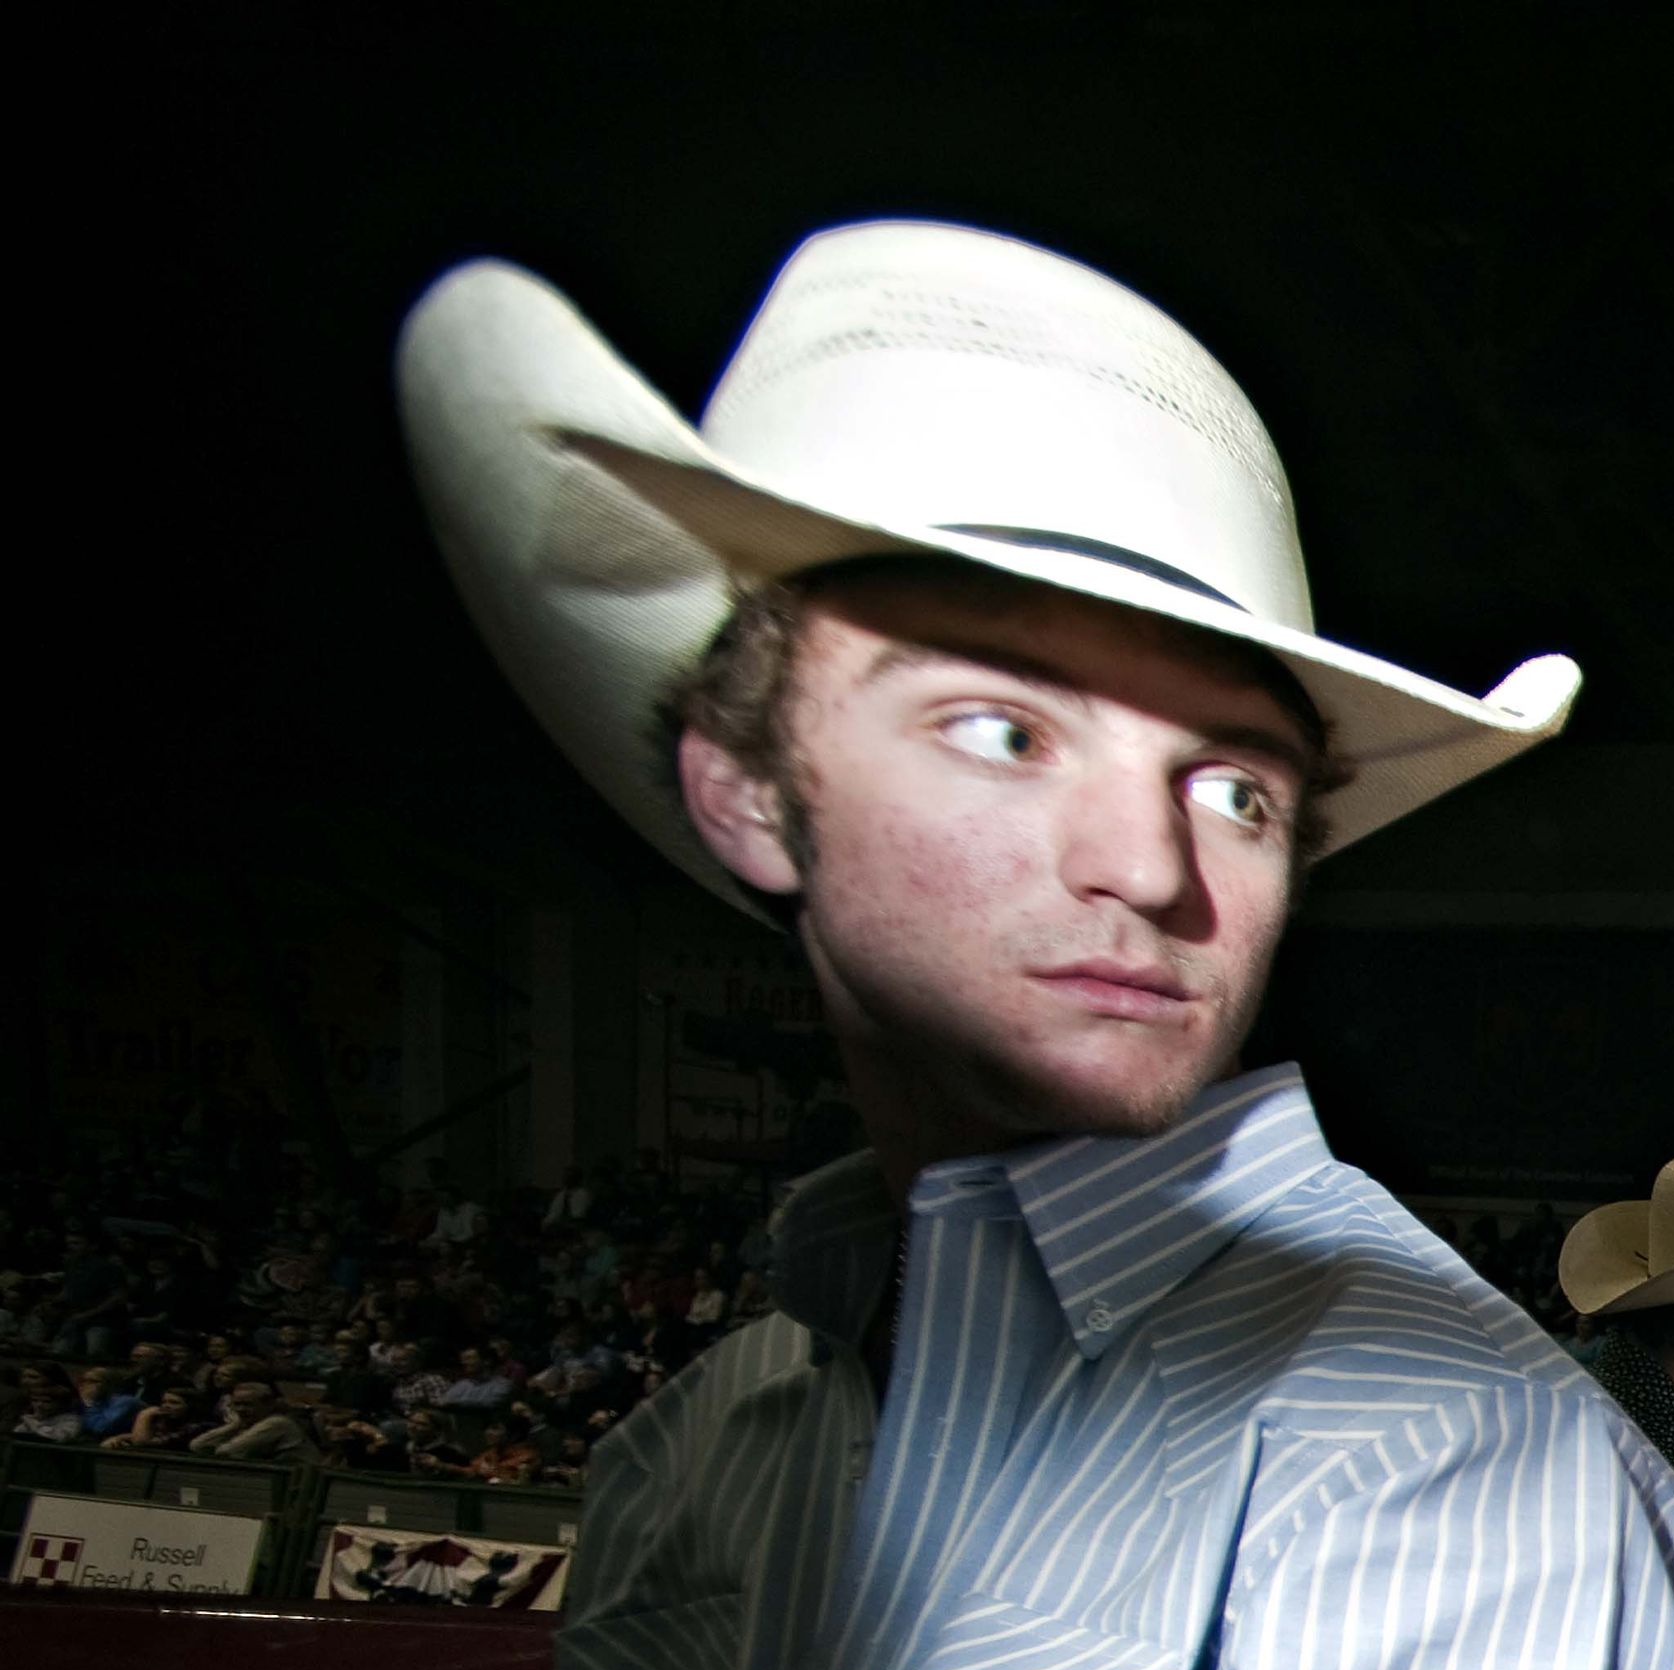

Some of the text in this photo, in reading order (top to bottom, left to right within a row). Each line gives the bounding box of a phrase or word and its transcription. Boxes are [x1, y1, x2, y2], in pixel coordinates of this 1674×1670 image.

[130, 1537, 208, 1568] Russell
[80, 1564, 134, 1592] Feed
[143, 1571, 157, 1592] &
